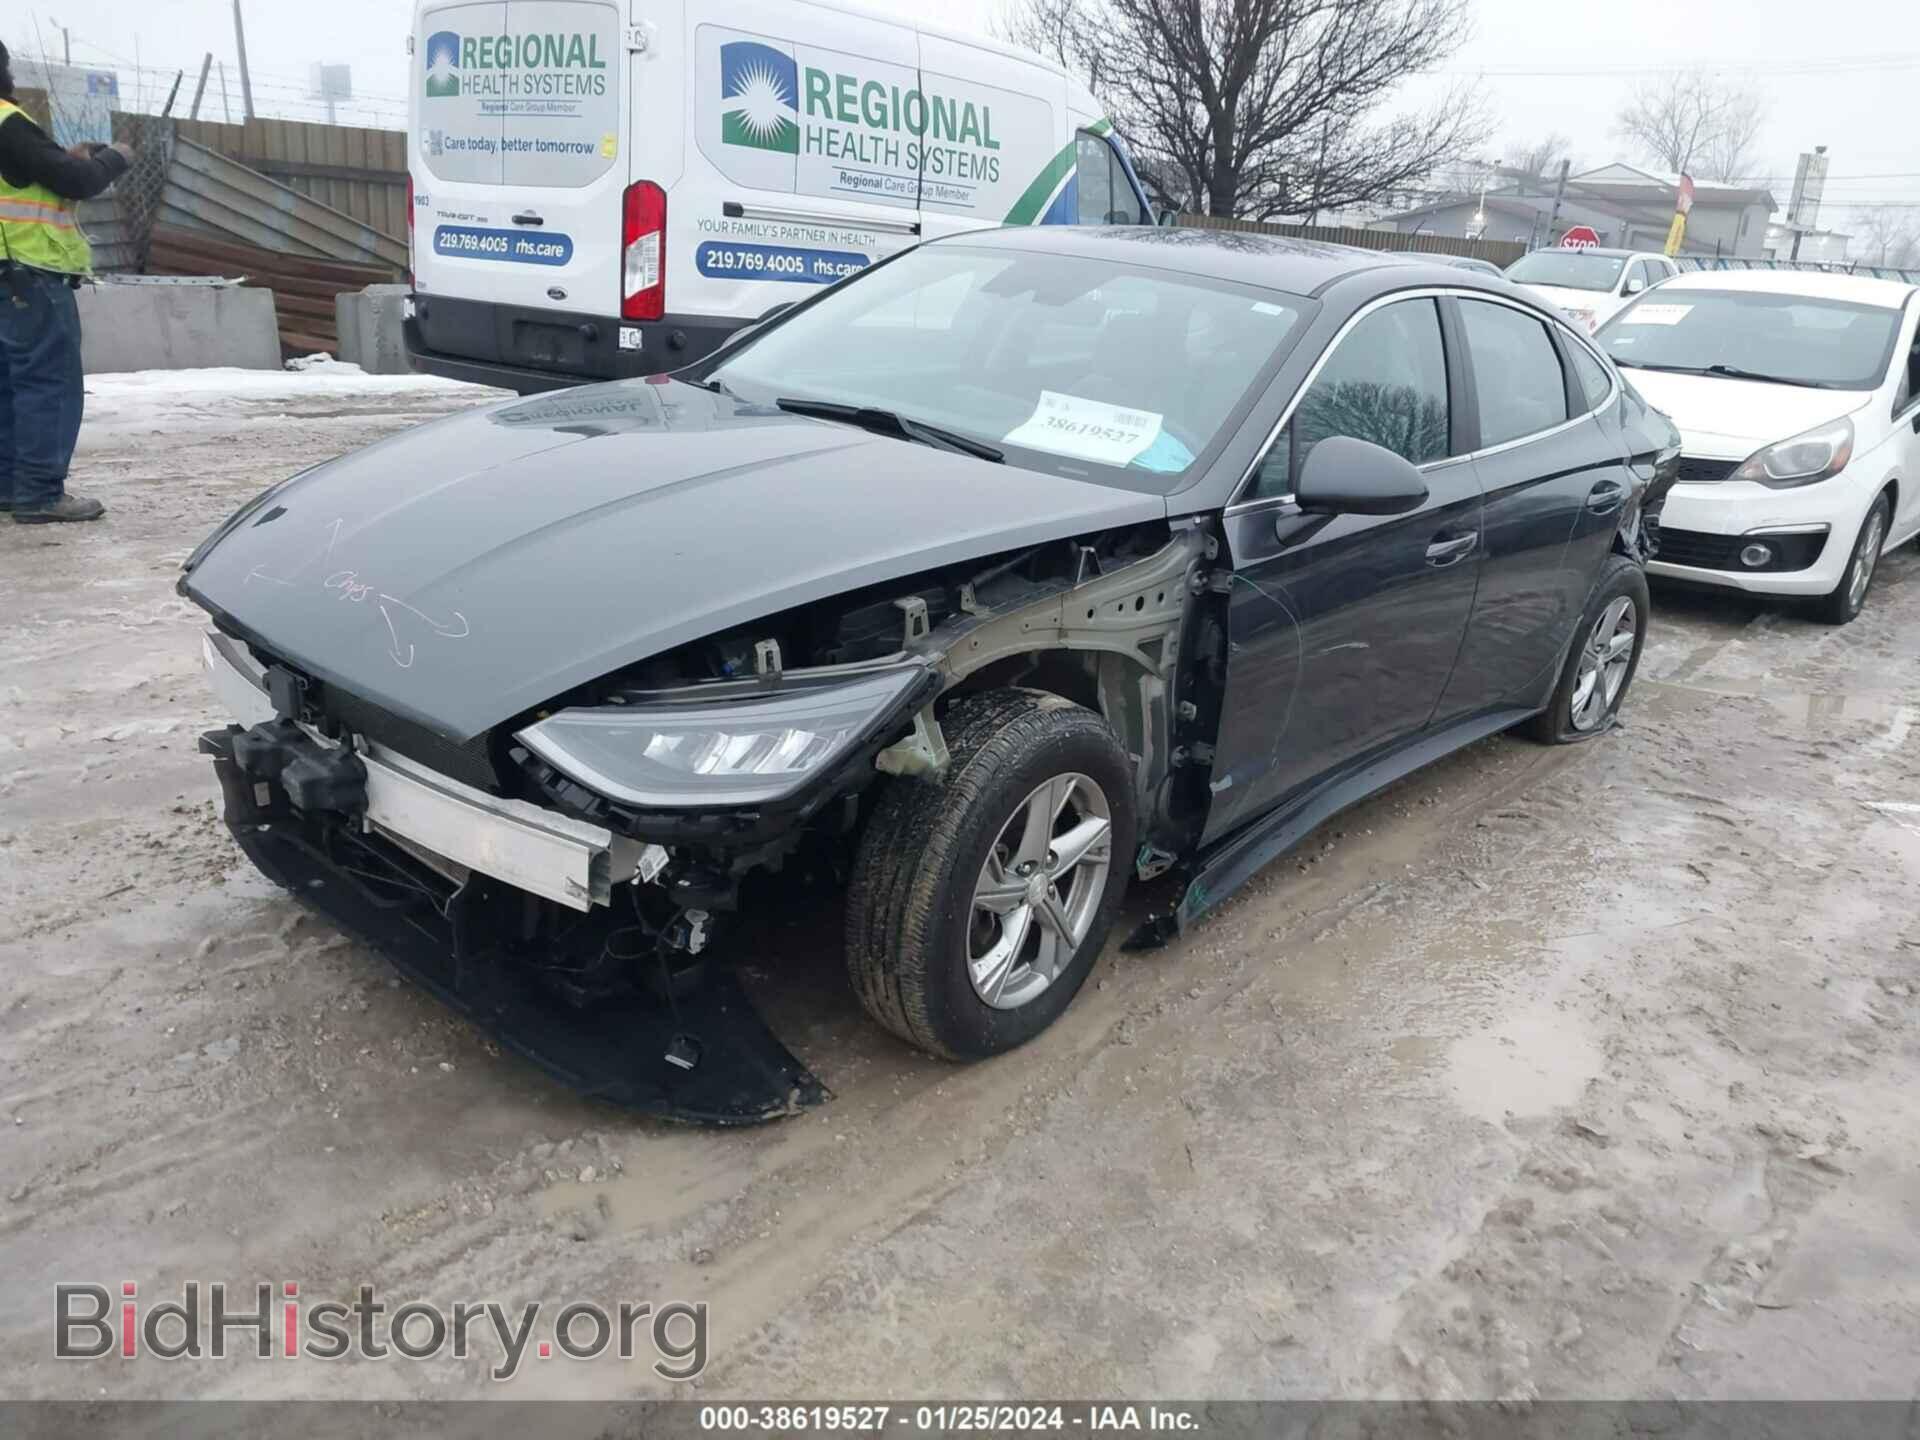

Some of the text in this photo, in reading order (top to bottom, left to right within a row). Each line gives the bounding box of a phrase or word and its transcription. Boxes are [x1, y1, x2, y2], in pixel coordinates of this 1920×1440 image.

[462, 33, 606, 70] REGIONAL
[462, 74, 606, 96] HEALTH SYSTEMS
[805, 66, 1001, 150] REGIONAL
[444, 137, 465, 149] Care
[501, 138, 533, 152] better
[535, 139, 595, 154] tomorrow
[806, 124, 1000, 183] HEALTH SYSTEMS
[839, 171, 970, 201] Regional Care Group Member
[440, 232, 564, 257] 219.769.4005 rhs.care
[698, 219, 876, 248] YOUR FAMILY'S PARTNER IN HEALTH
[1563, 238, 1597, 249] STOP
[707, 250, 804, 272] 219.769.4005
